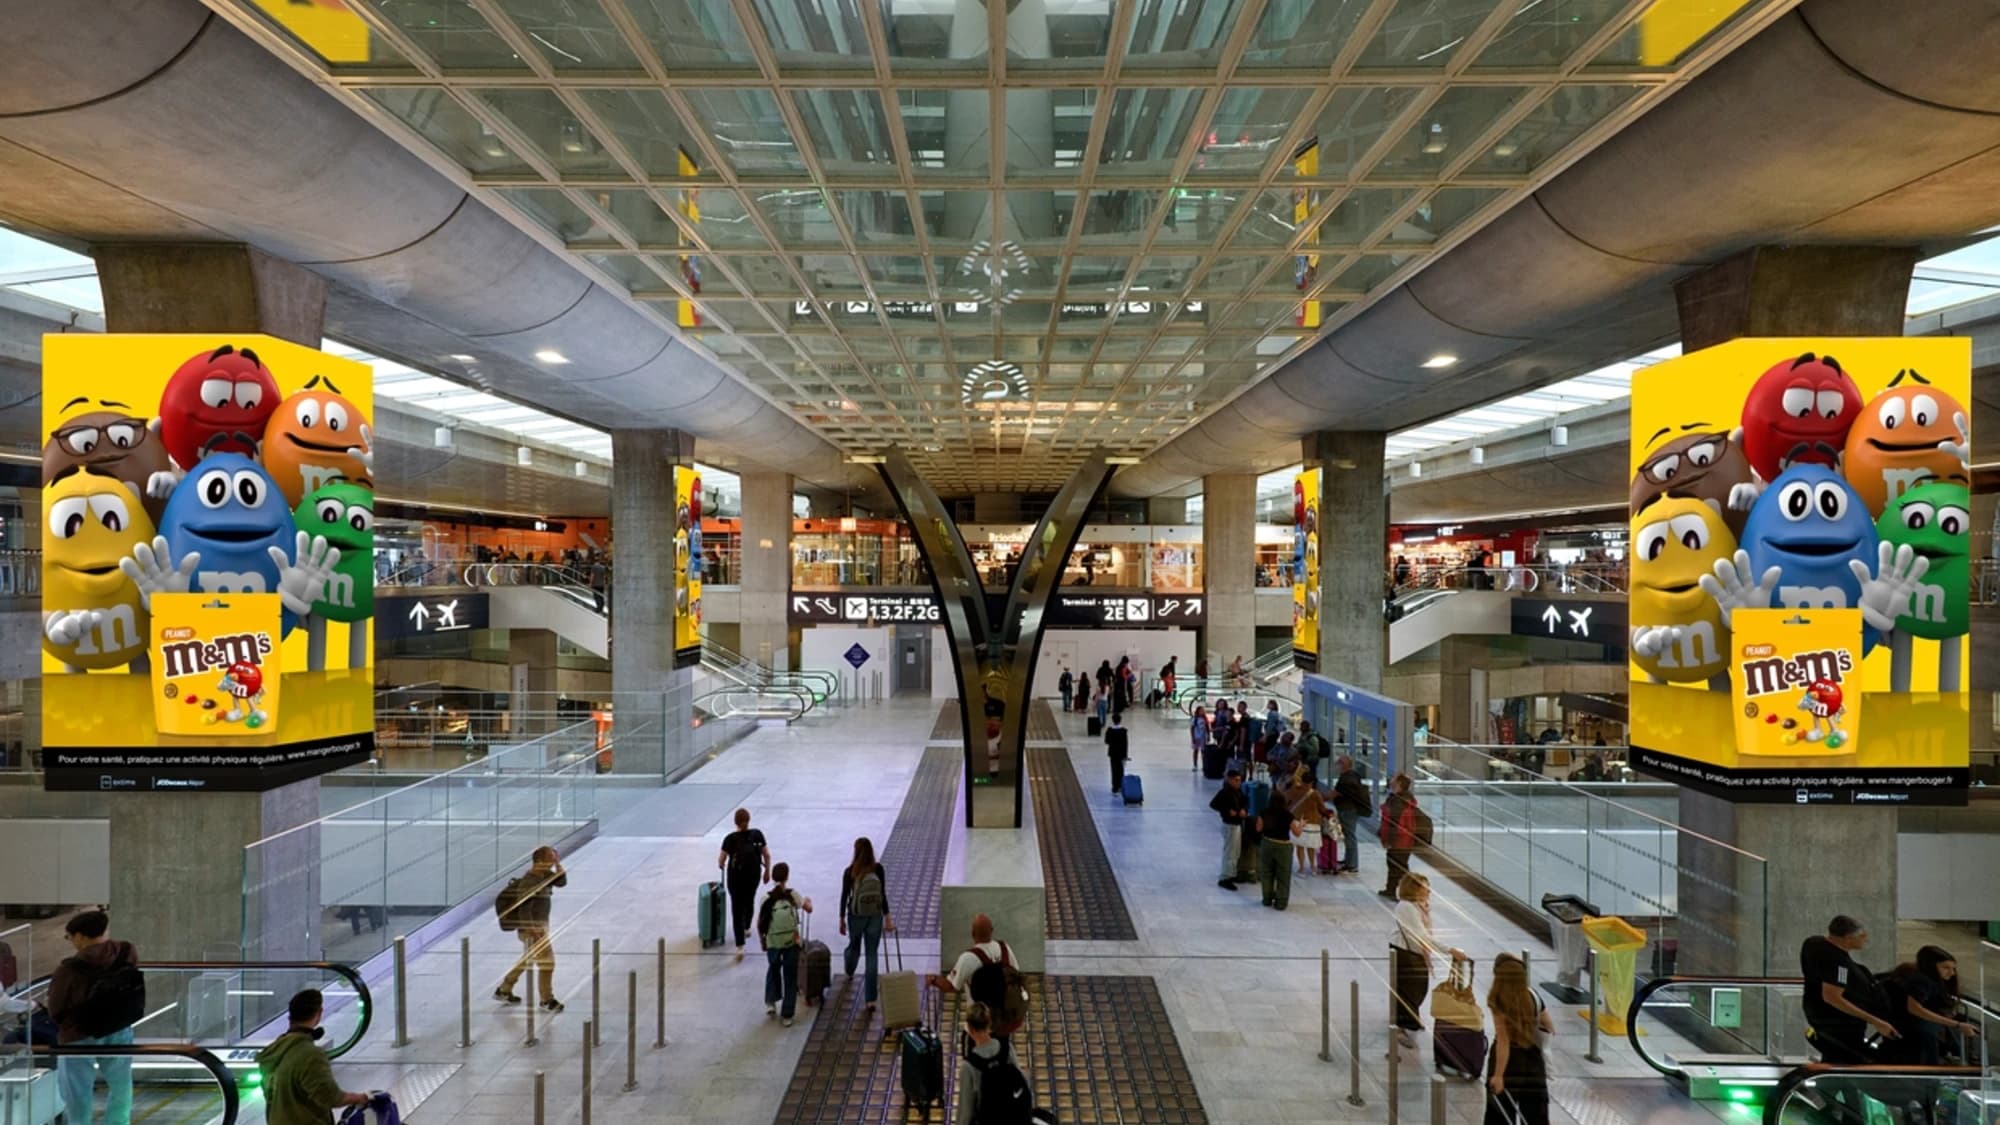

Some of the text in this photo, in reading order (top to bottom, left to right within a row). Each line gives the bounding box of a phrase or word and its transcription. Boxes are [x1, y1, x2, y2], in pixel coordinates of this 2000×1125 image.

[869, 597, 902, 606] Terminal
[1062, 598, 1096, 606] Terminal
[1104, 607, 1124, 620] 2E
[165, 628, 192, 638] PEANUT
[1746, 645, 1773, 656] PEANUT
[58, 754, 77, 763] Pour
[79, 755, 99, 763] votre
[101, 754, 125, 765] santé,
[127, 755, 164, 765] pratiquez
[182, 754, 210, 763] activité
[212, 755, 247, 764] physique
[1642, 755, 1659, 766] Pour
[1660, 760, 1679, 771] votre
[1706, 772, 1744, 786] pratiquez
[1762, 776, 1790, 785] activité
[1791, 777, 1827, 786] physique
[1868, 776, 1953, 786] www.mangerbouger.fr
